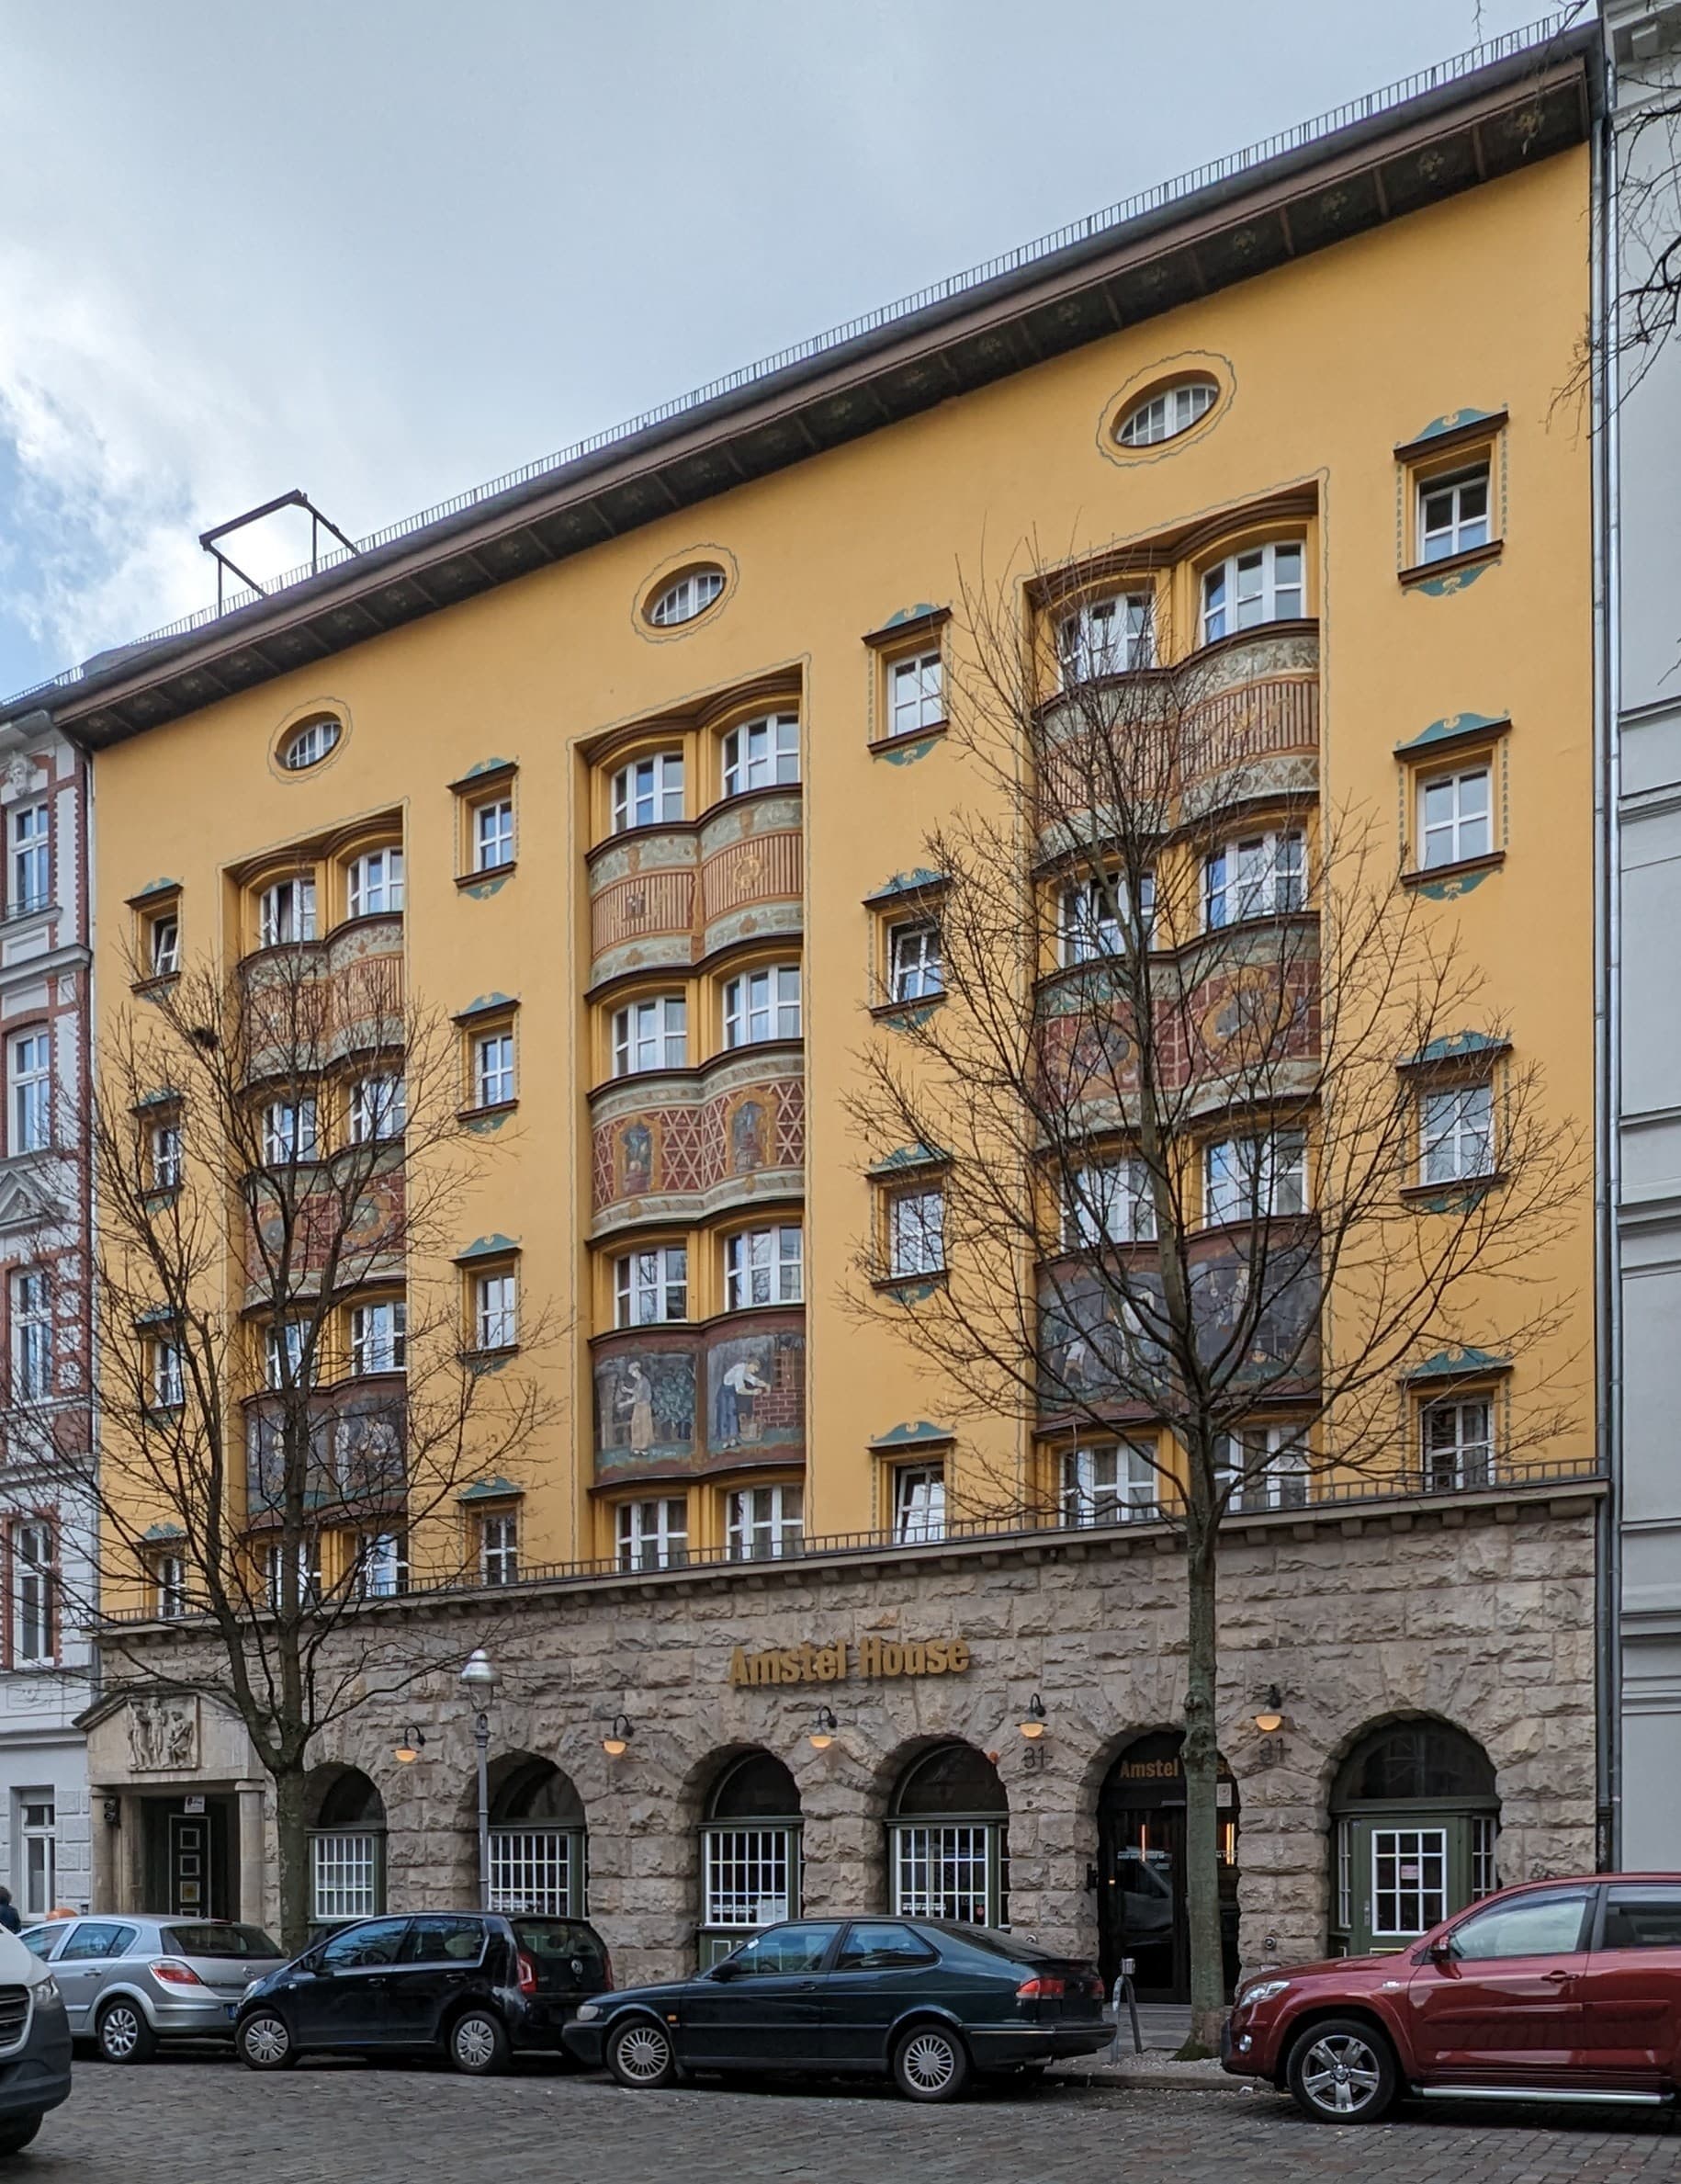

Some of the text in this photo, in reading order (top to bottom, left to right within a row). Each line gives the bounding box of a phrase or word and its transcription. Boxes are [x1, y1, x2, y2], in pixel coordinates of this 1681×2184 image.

[728, 1635, 970, 1686] Amstel House
[1022, 1745, 1045, 1770] 31
[1120, 1758, 1179, 1779] Amstel
